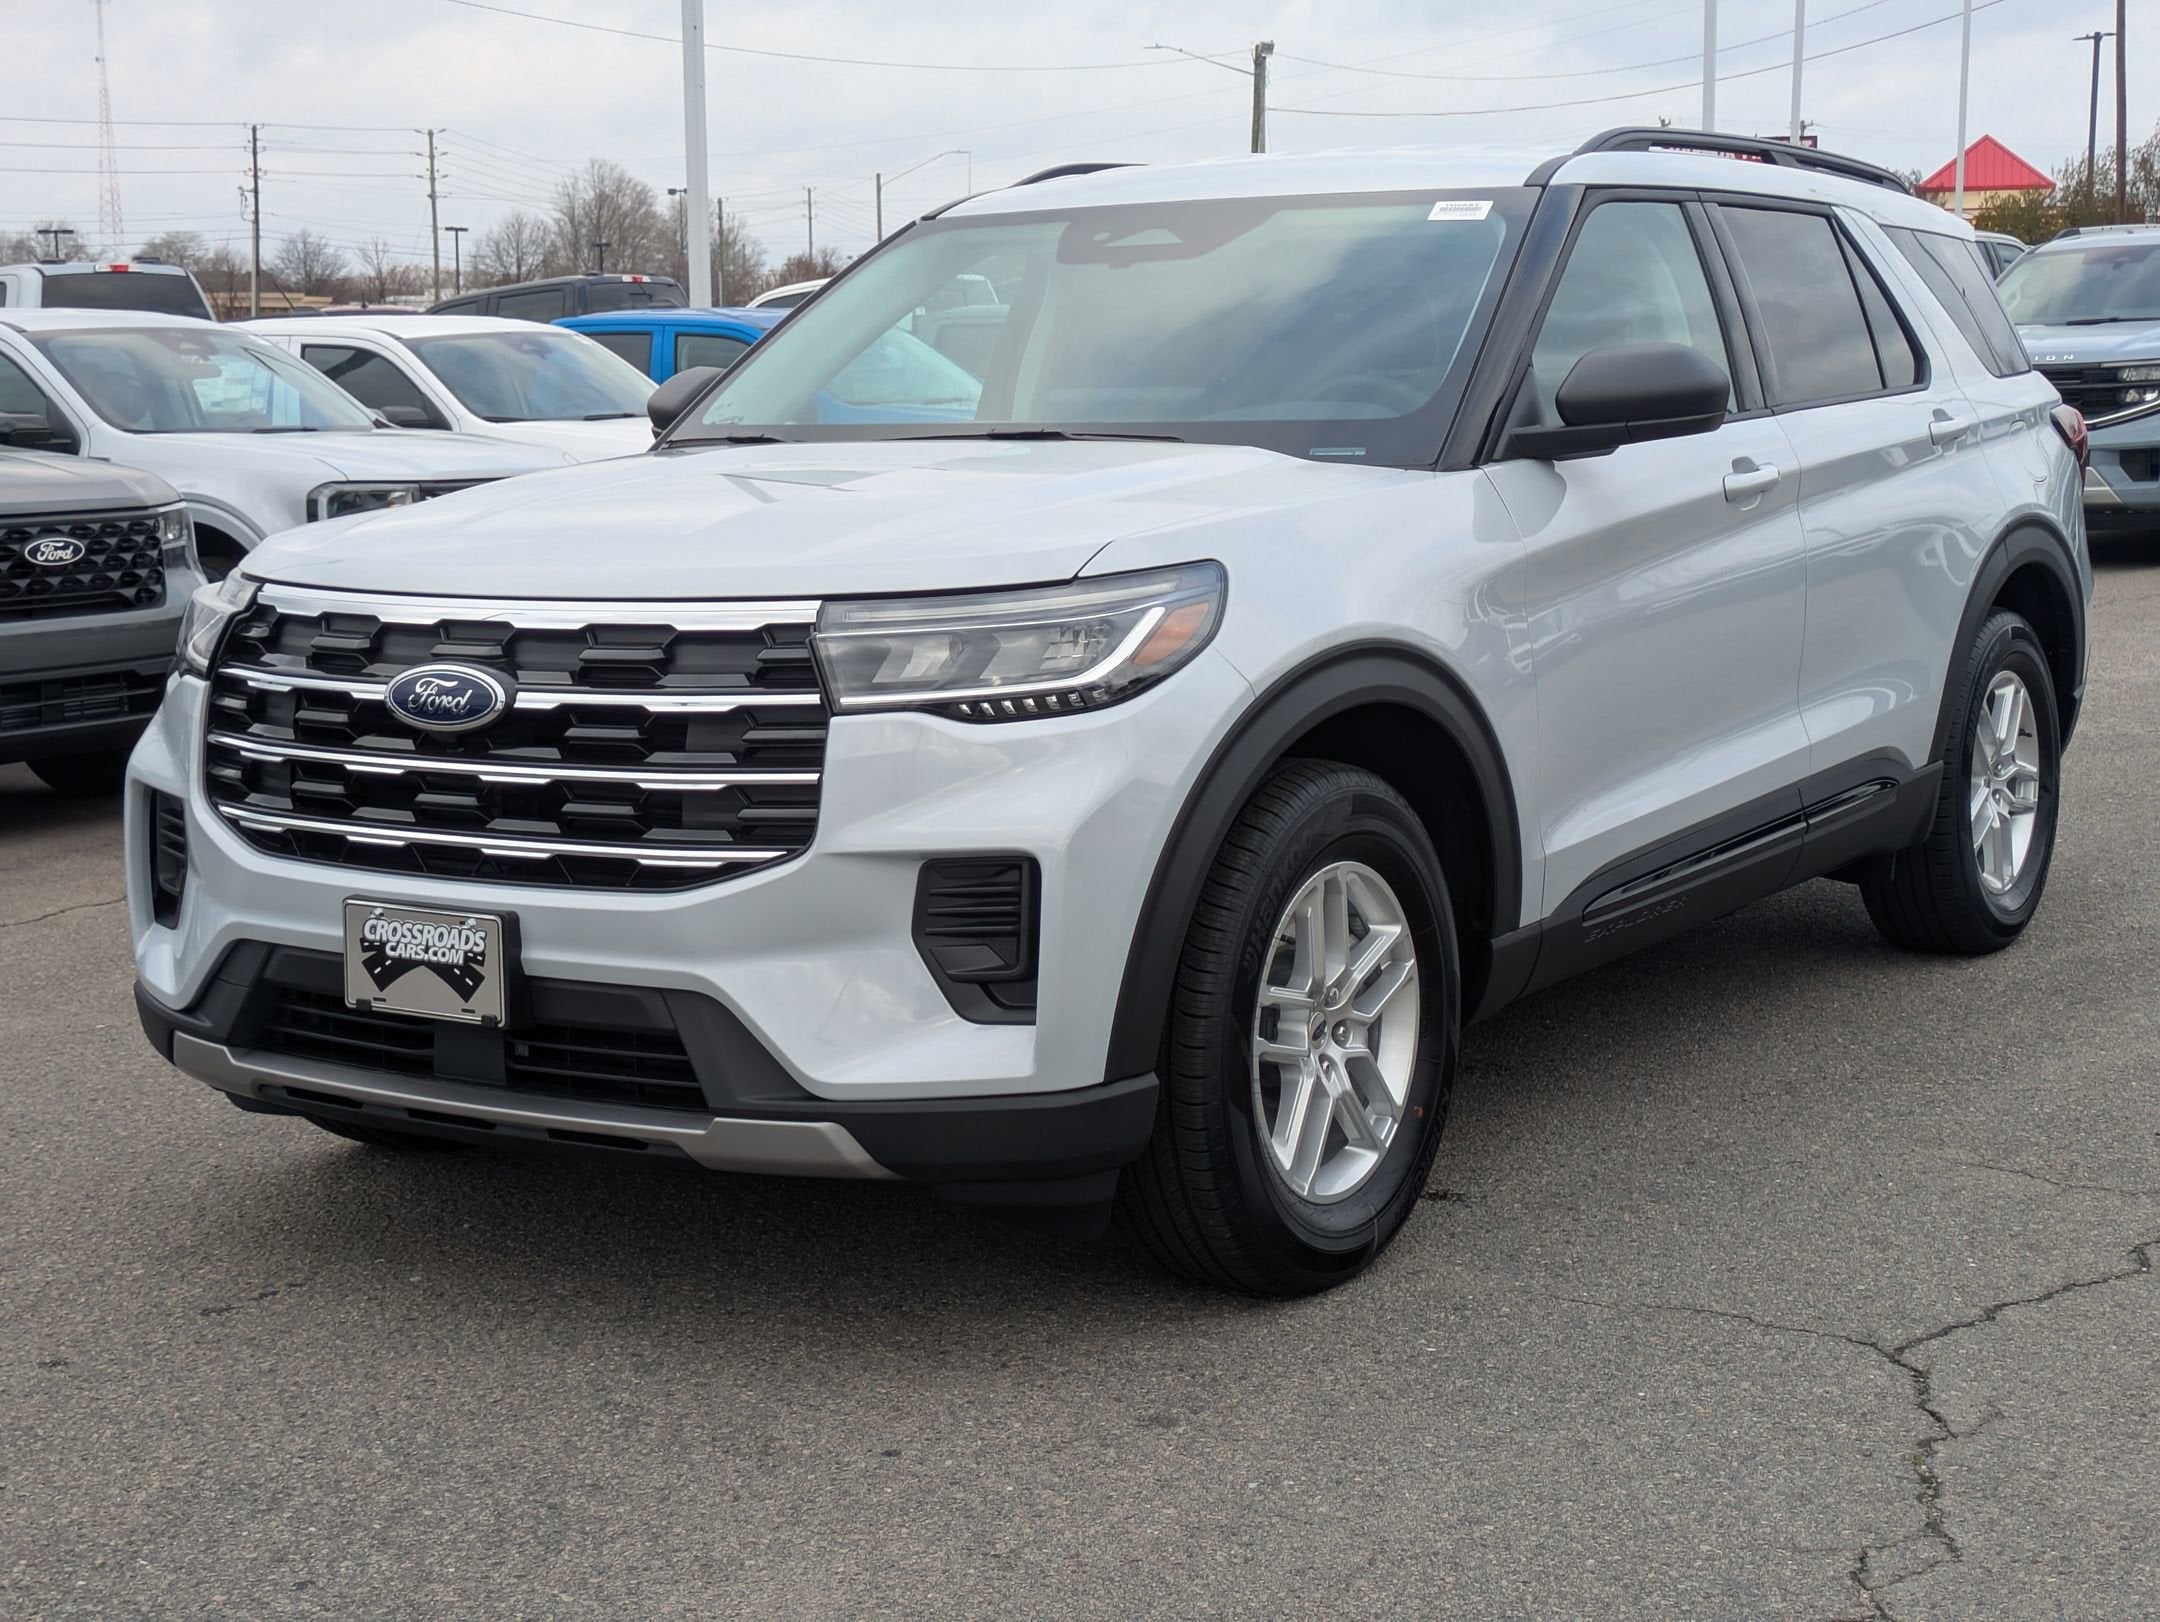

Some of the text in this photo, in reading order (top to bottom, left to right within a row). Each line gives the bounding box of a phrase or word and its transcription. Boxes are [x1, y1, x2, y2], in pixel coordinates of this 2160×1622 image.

[36, 541, 74, 561] Ford
[407, 677, 473, 715] Ford
[362, 917, 488, 952] CROSSROADS
[1584, 896, 1689, 944] EXPLORER
[384, 941, 465, 965] CARS.COM
